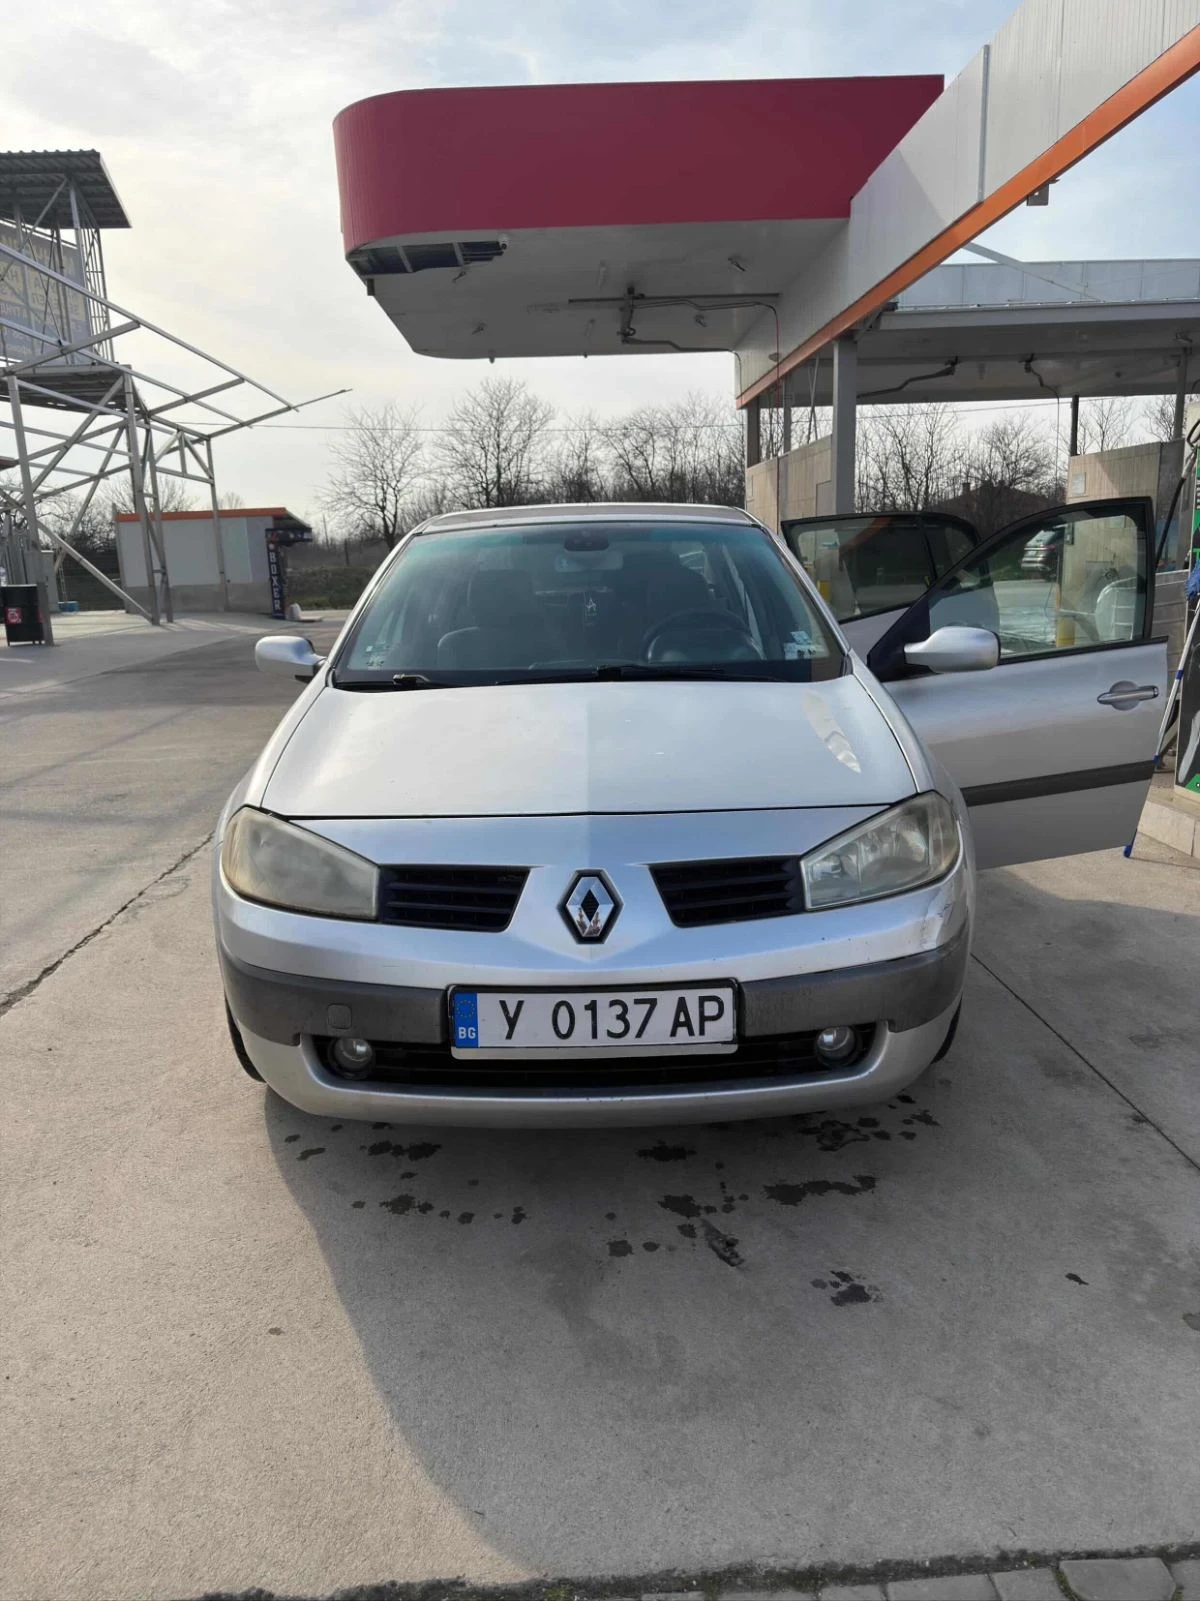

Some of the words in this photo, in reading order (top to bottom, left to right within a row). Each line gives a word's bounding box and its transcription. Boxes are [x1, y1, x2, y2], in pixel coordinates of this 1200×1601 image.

[269, 551, 281, 610] BOXER
[458, 1026, 476, 1039] BG
[552, 997, 658, 1040] 0137
[669, 995, 725, 1038] AP
